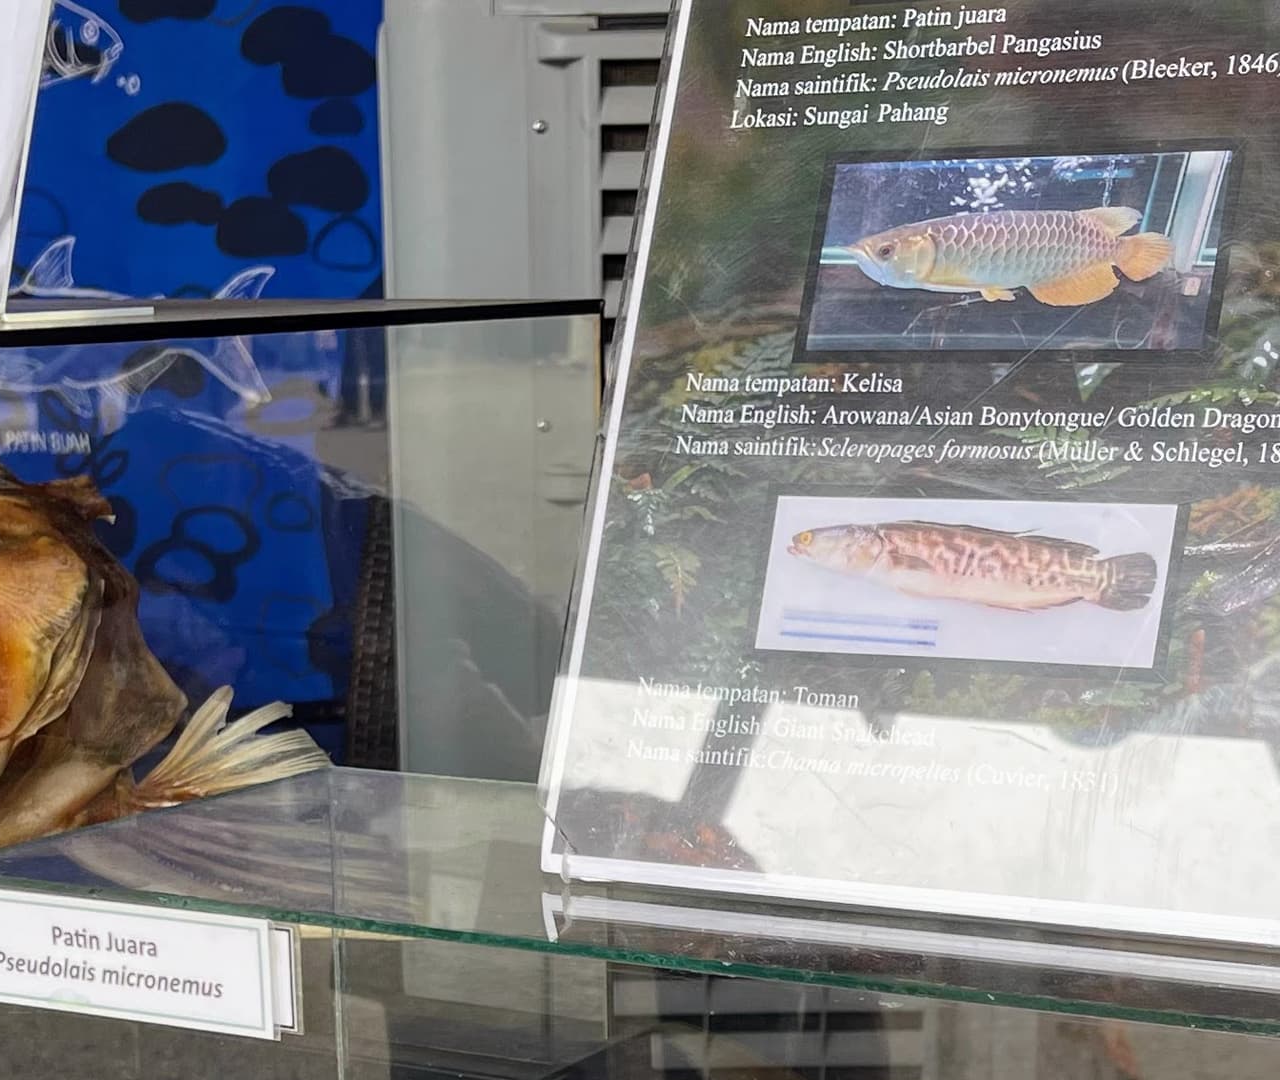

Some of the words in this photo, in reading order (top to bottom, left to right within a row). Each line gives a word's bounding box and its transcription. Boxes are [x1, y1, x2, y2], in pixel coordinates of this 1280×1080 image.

[745, 18, 800, 37] Nama
[805, 14, 896, 37] tempatan:
[903, 6, 952, 27] Patin
[955, 8, 1007, 30] juara
[741, 48, 795, 67] Nama
[800, 44, 877, 67] English:
[883, 36, 995, 60] Shortbarbel
[1002, 30, 1102, 57] Pangasius
[736, 79, 789, 98] Nama
[794, 73, 876, 95] saintifik:
[882, 69, 989, 92] Pseudolais
[993, 65, 1118, 86] micronemus
[1121, 57, 1218, 85] (Bleeker,
[730, 109, 798, 129] Lokasi:
[803, 104, 869, 129] Sungai
[877, 102, 949, 124] Pahang
[686, 373, 739, 393] Nama
[745, 373, 835, 396] tempatan:
[842, 372, 903, 393] Kelisa
[681, 405, 734, 424] Nama
[740, 404, 816, 427] English:
[822, 404, 973, 426] Arowana/Asian
[979, 405, 1114, 429] Bonytongue/
[1118, 407, 1194, 429] Golden
[675, 436, 729, 456] Nama
[937, 438, 1032, 463] formosus
[1039, 441, 1117, 463] (Müller
[1124, 441, 1143, 461] &
[1151, 442, 1249, 467] Schlegel,
[637, 676, 690, 698] Nama
[696, 682, 787, 706] tempatan:
[793, 686, 859, 708] Toman
[632, 708, 685, 731] Nama
[691, 712, 767, 737] English:
[774, 718, 826, 740] Giant
[627, 740, 680, 762] Nama
[52, 925, 100, 952] Patin
[106, 933, 158, 958] Juara
[102, 967, 224, 1000] micronemus
